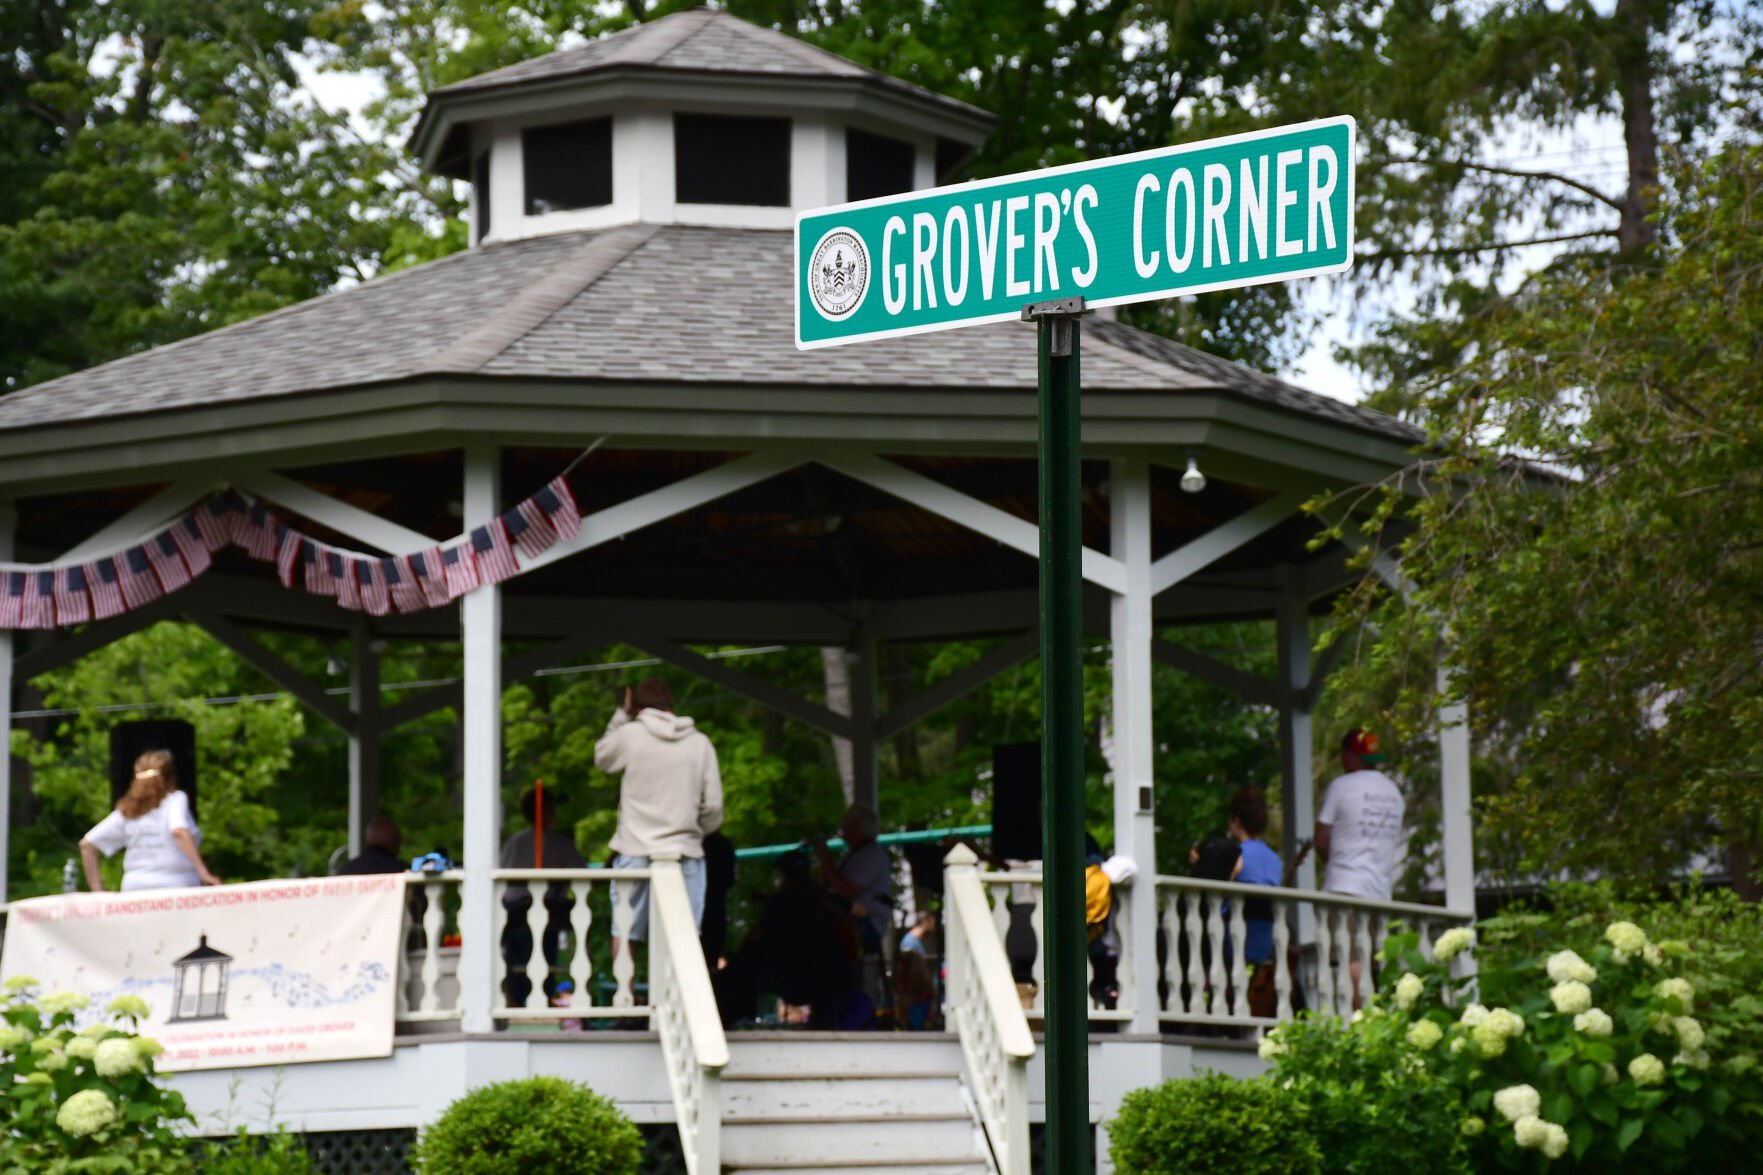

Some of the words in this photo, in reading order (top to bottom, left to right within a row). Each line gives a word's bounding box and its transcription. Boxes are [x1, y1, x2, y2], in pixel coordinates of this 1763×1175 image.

[882, 183, 1099, 316] GROVER'S
[1133, 144, 1339, 279] CORNER
[831, 303, 846, 312] 1761
[105, 898, 173, 916] BANDSTAND
[176, 891, 244, 911] DEDICATION
[247, 890, 258, 902] IN
[261, 887, 301, 900] HONOR
[304, 884, 319, 898] OF
